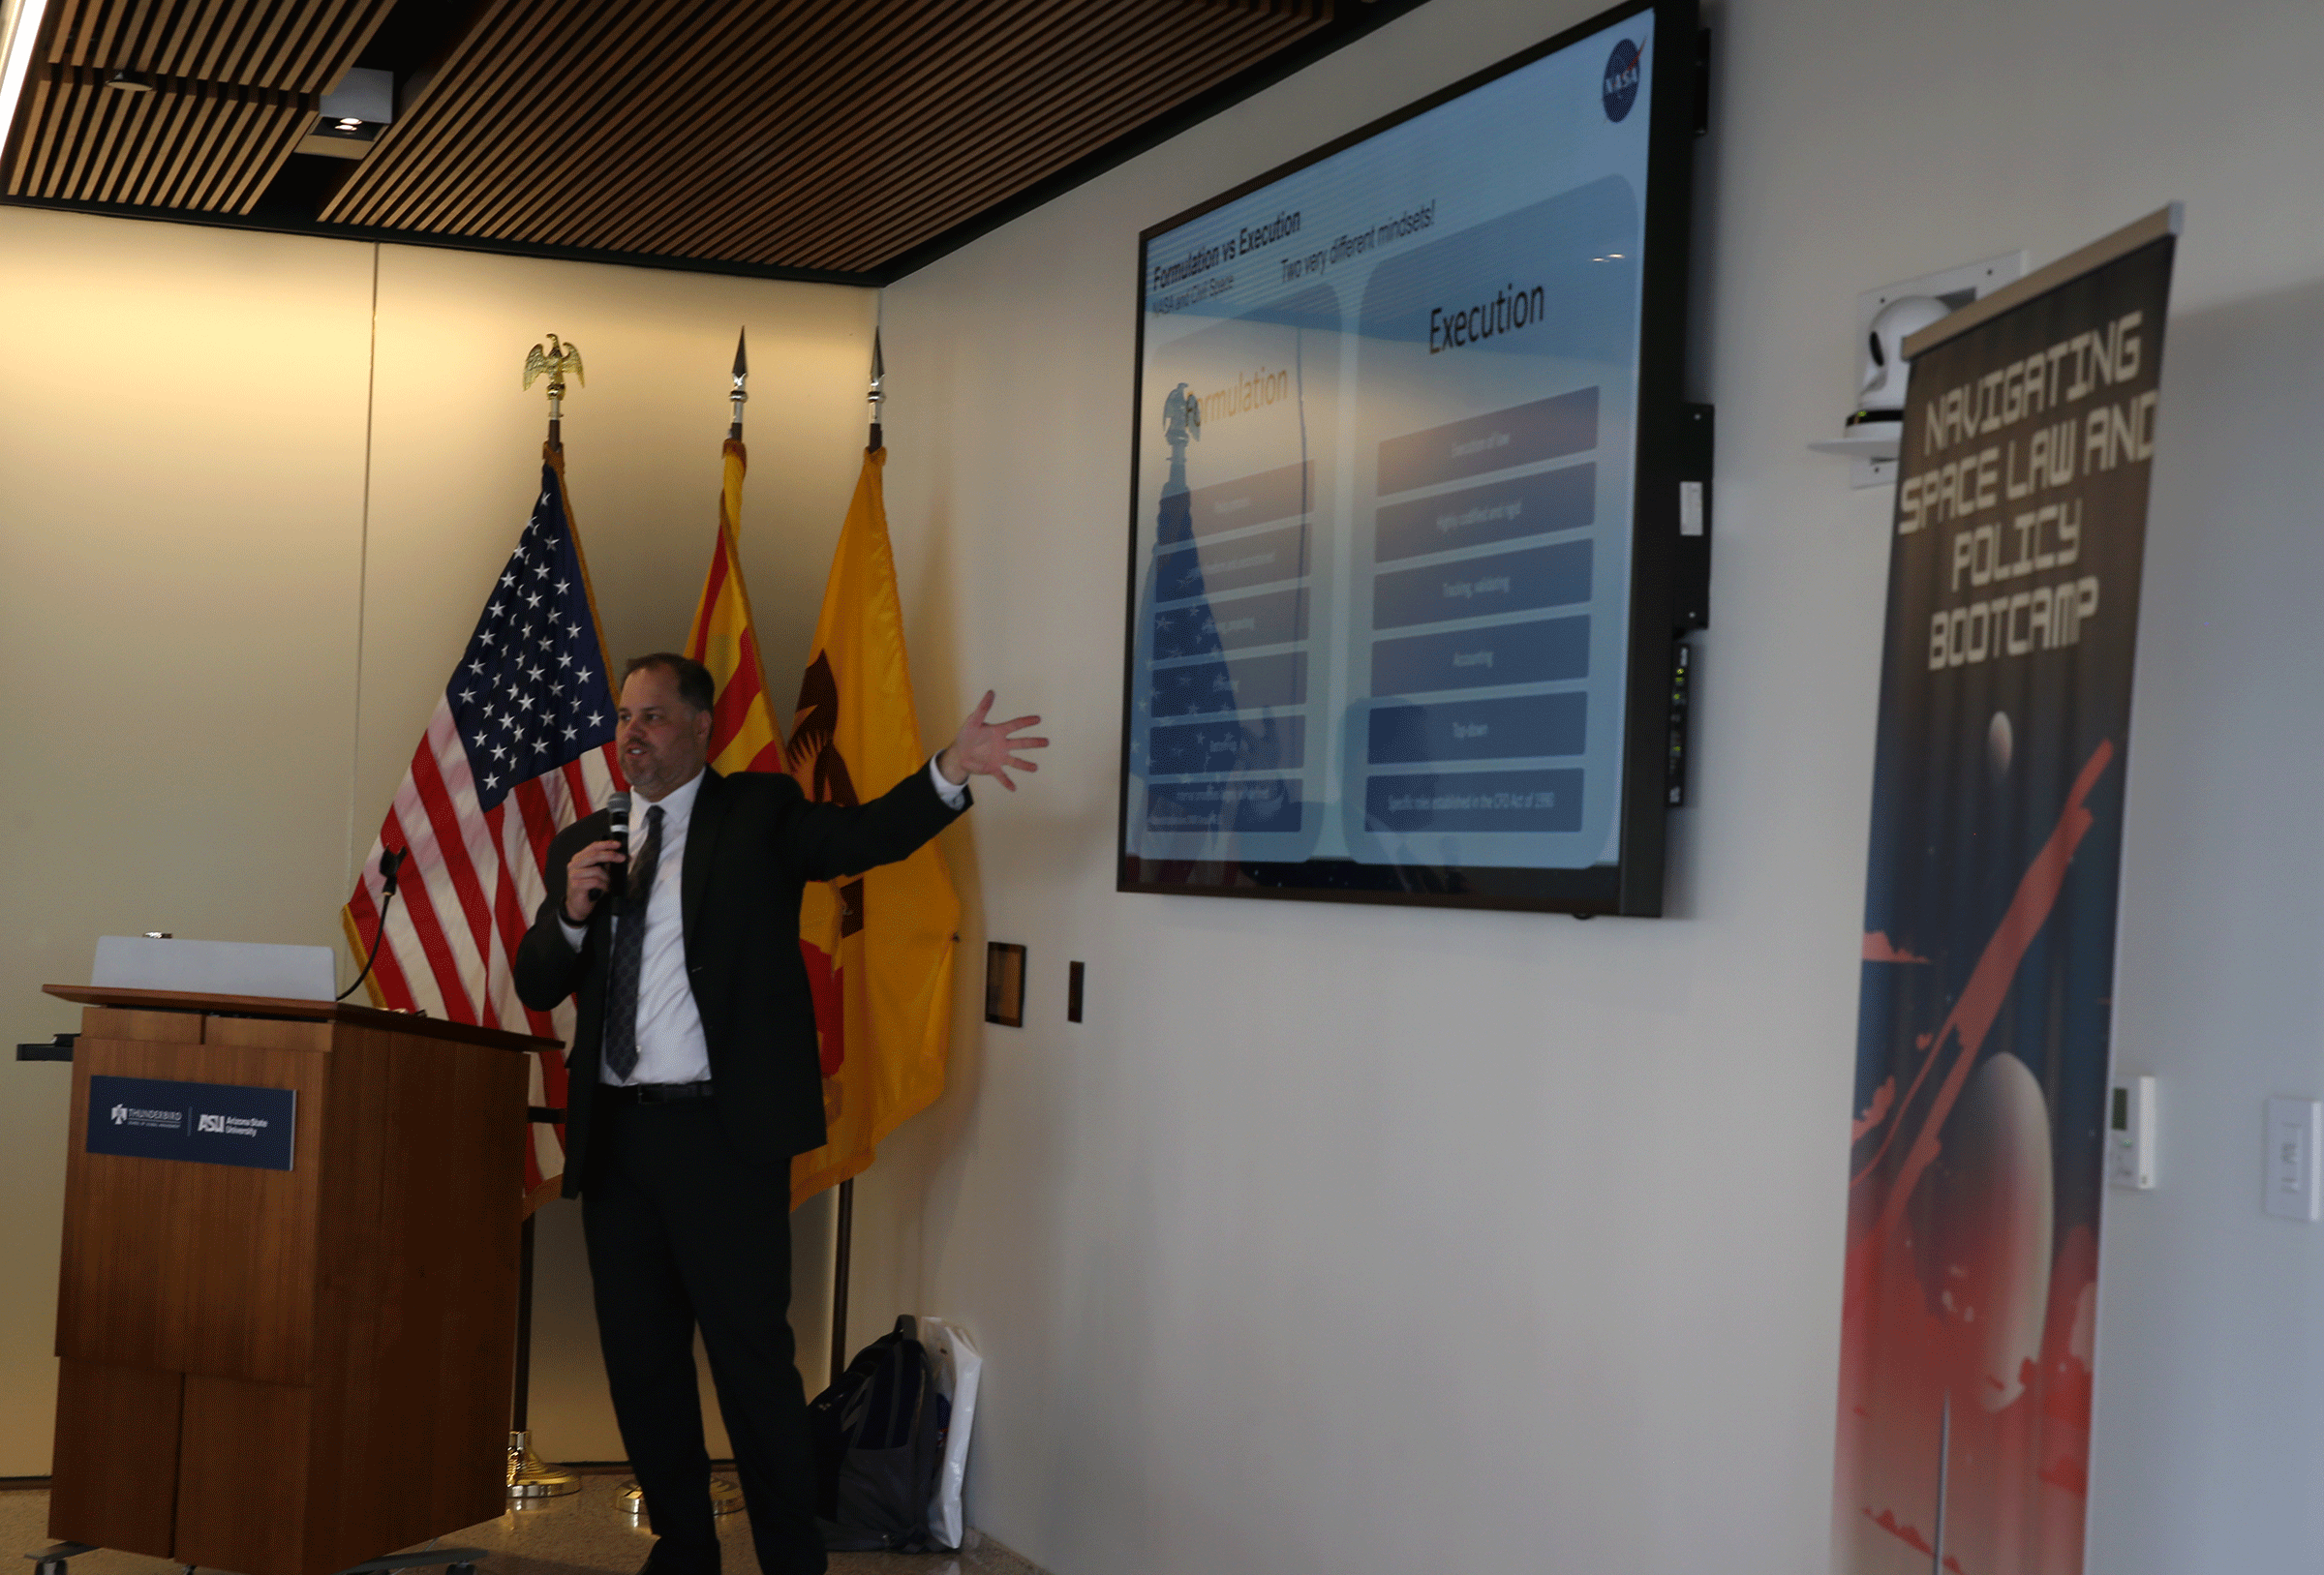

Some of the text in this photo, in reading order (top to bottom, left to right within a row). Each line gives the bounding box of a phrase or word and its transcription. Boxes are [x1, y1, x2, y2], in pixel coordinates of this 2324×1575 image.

[1605, 67, 1638, 94] NASA
[1152, 210, 1301, 290] Formulation vs Execution
[1280, 199, 1436, 283] Two very different mindsets!
[1430, 283, 1544, 354] Execution
[1185, 366, 1289, 427] Formulation
[1924, 310, 2144, 456] NAVIGATING
[1898, 387, 2158, 535] SPACE LAW AND
[1951, 497, 2083, 592] POLICY
[1928, 575, 2099, 671] BOOTCAMP
[128, 1108, 183, 1121] THUNDERBIRD
[198, 1114, 225, 1134] ASU
[226, 1125, 258, 1137] University
